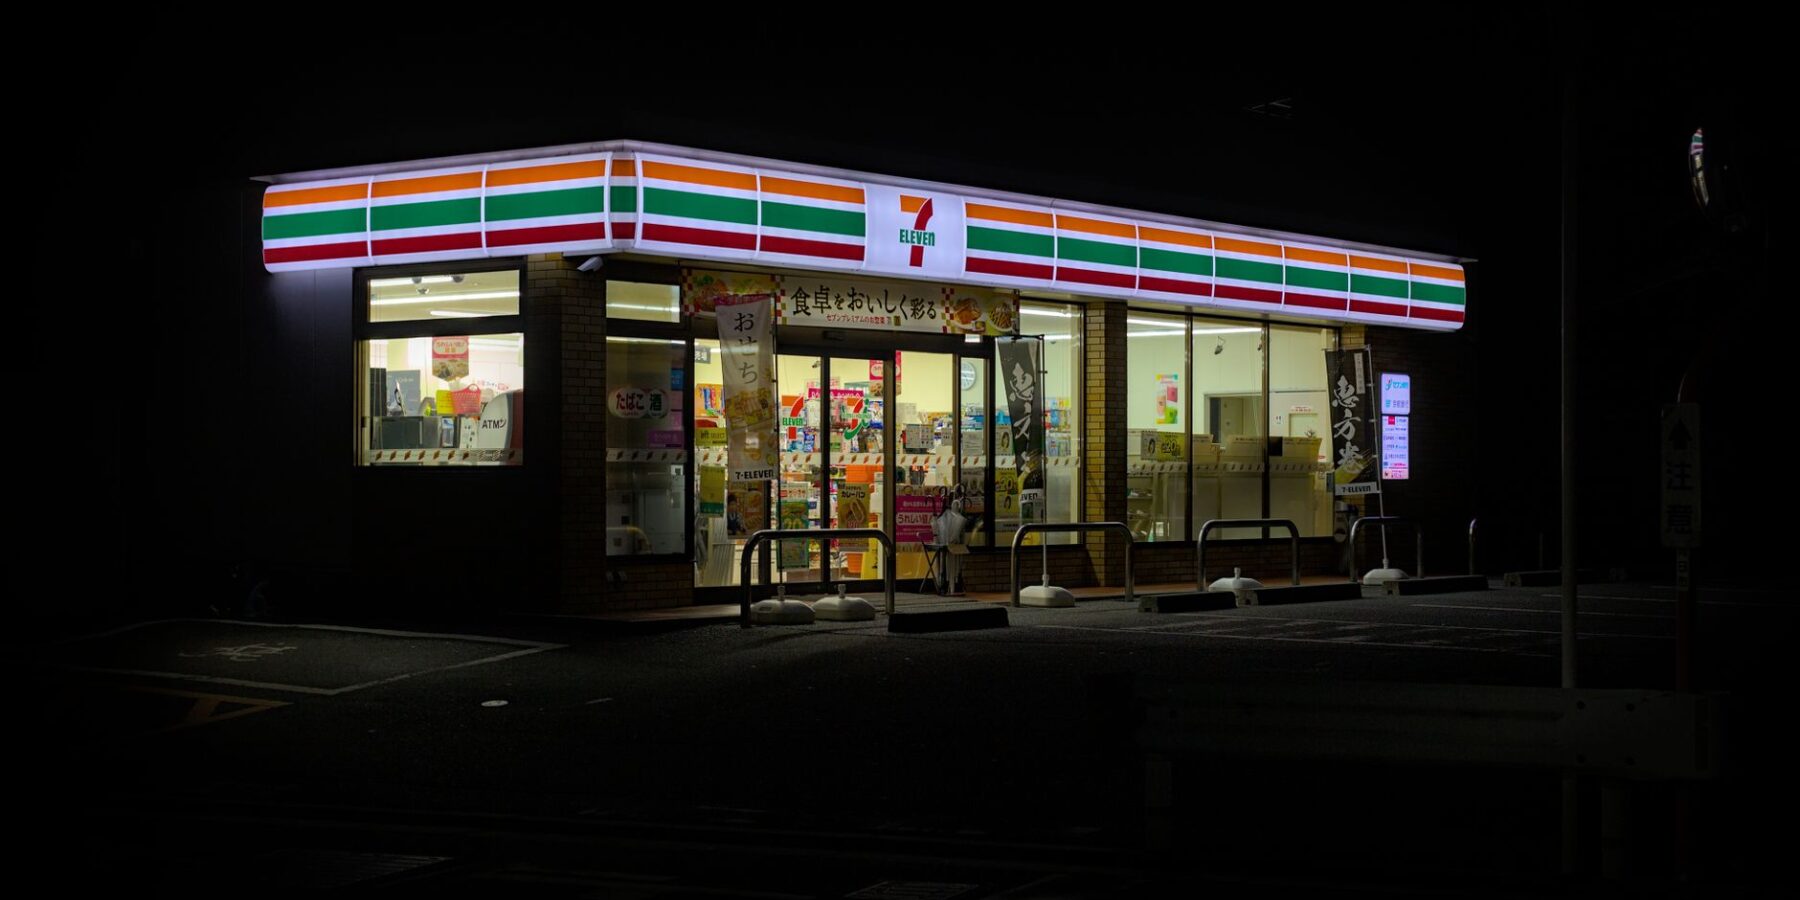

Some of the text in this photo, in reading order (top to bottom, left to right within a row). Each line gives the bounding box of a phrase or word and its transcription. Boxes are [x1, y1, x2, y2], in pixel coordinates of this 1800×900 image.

[900, 194, 933, 268] 7
[789, 284, 937, 321] 食卓をおいしく彩る
[734, 312, 758, 385] おせち
[482, 419, 500, 429] ATM
[616, 391, 645, 410] たばこ
[650, 393, 662, 411] 酒
[1331, 374, 1363, 471] 恵方巻
[1666, 461, 1694, 535] 注意
